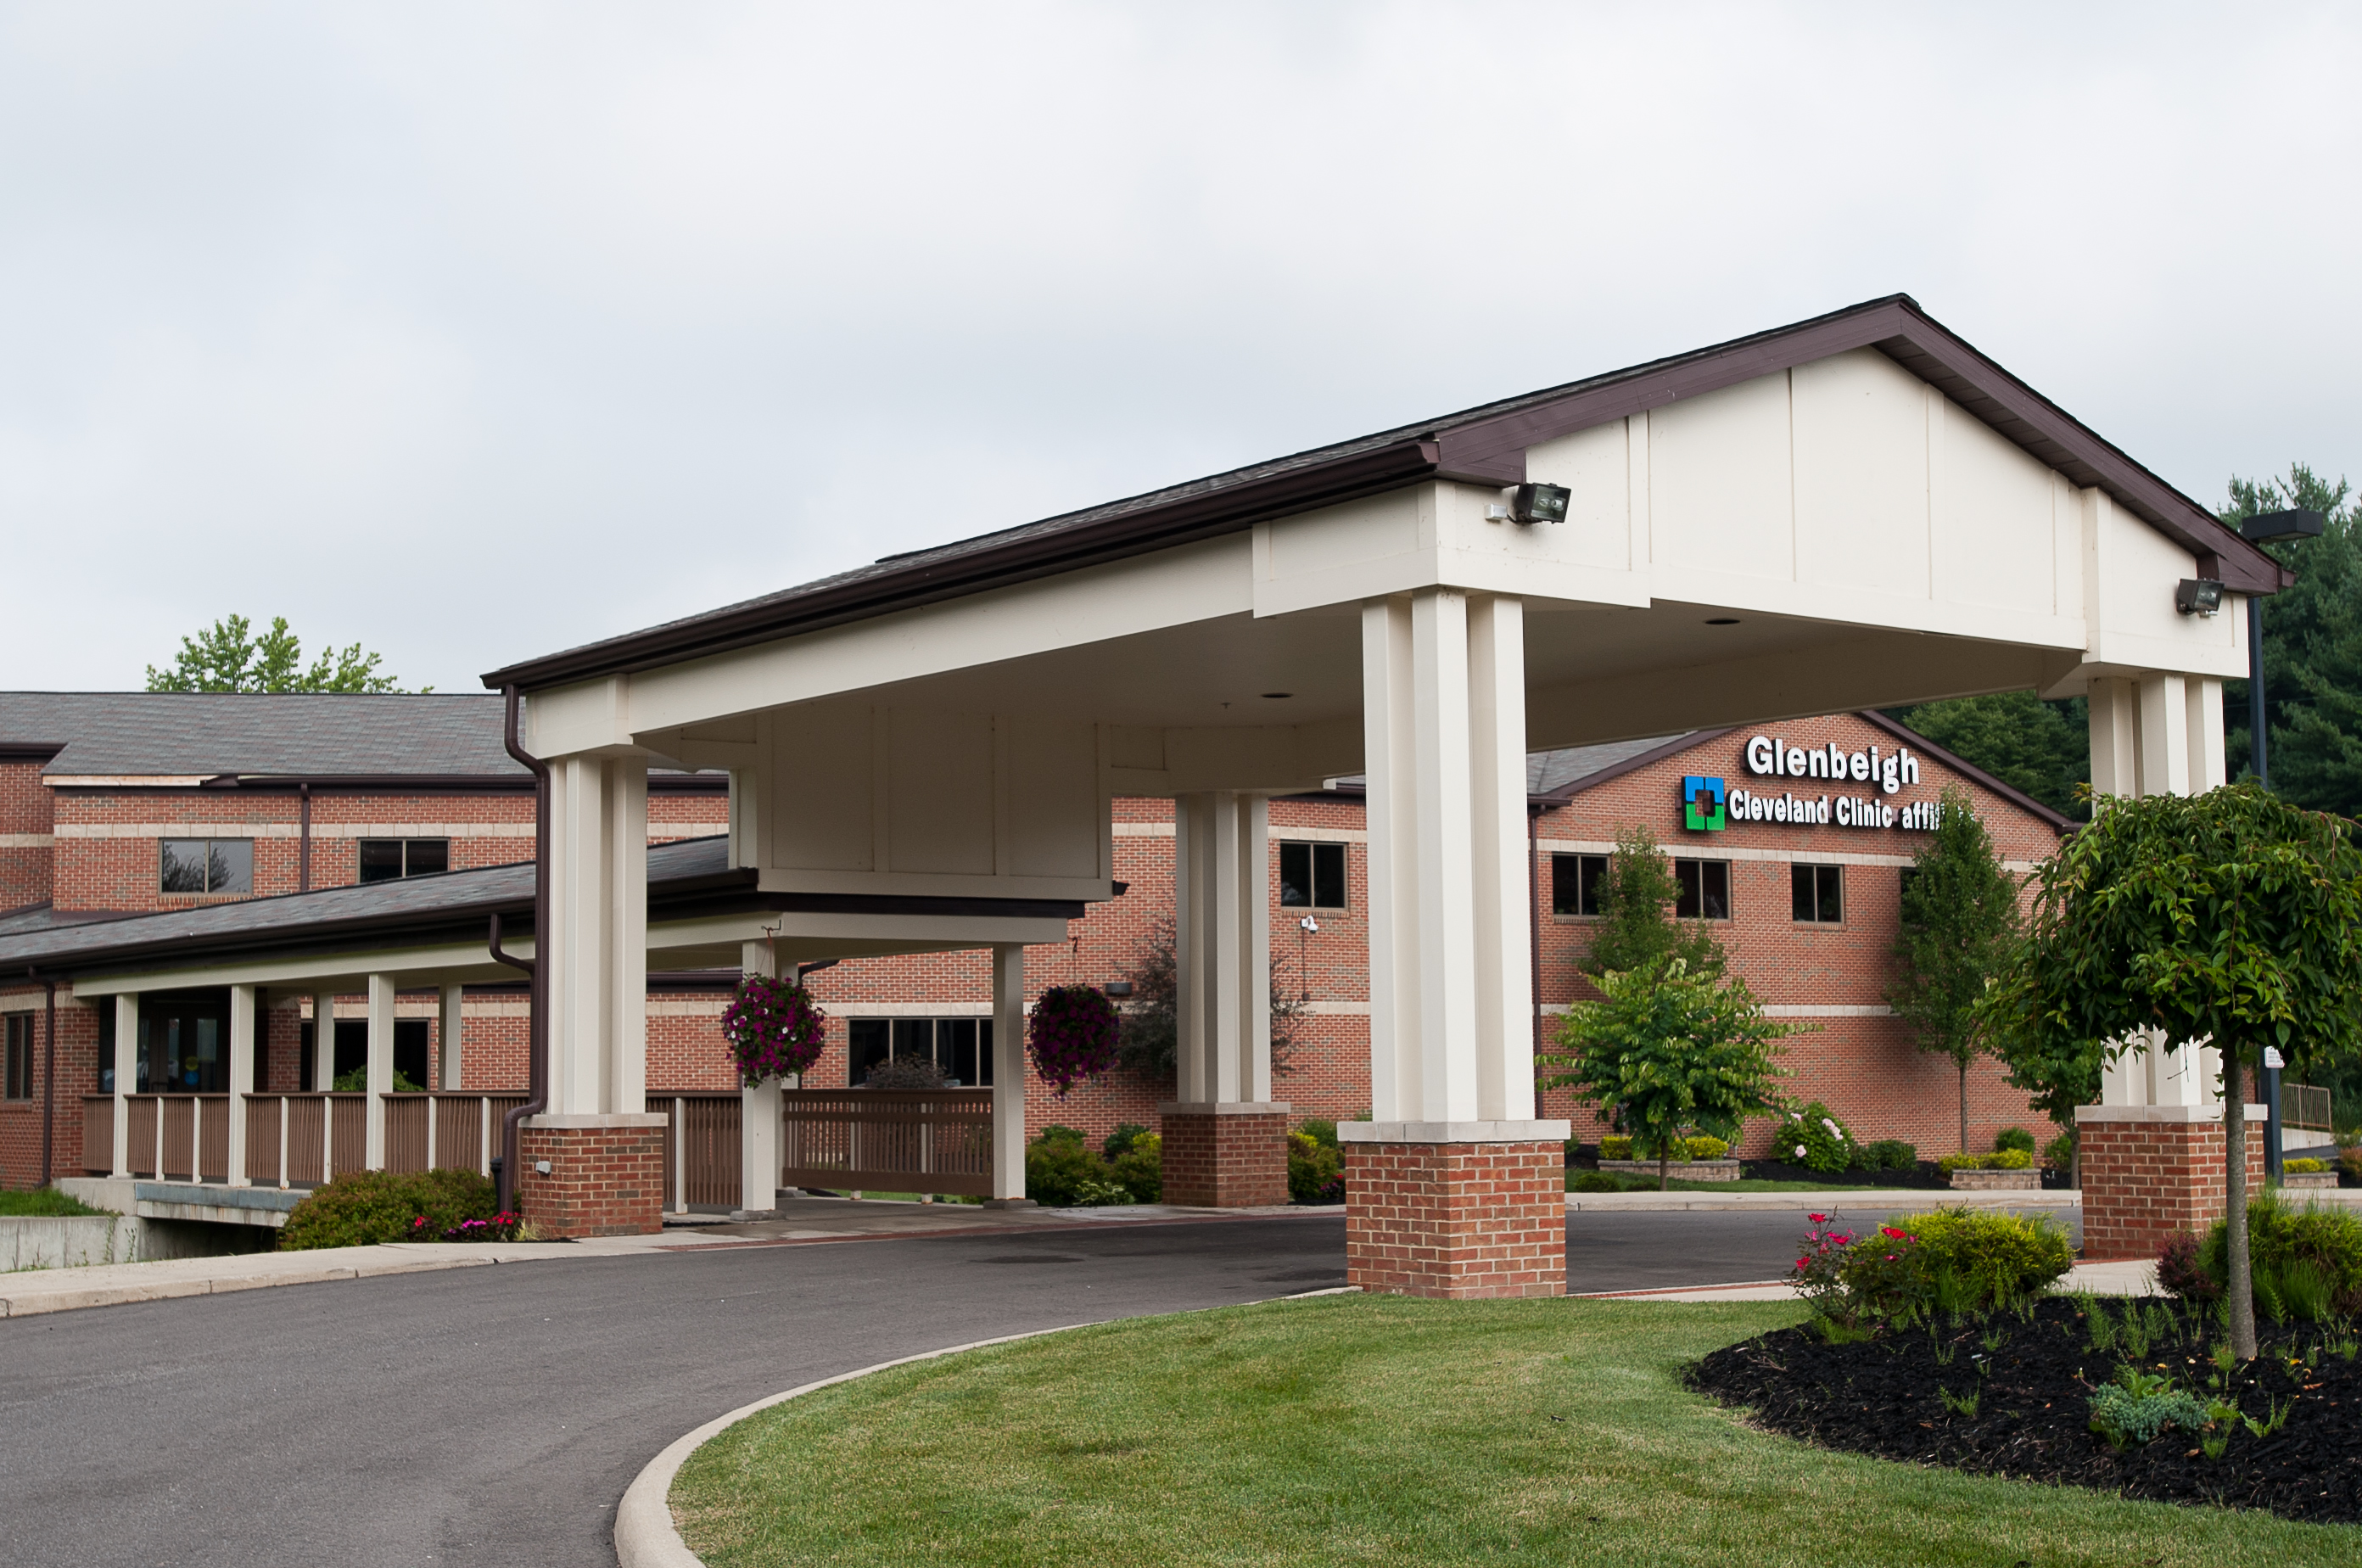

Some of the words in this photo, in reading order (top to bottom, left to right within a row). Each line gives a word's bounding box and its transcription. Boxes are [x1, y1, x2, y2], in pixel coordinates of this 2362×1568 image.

[1747, 736, 1919, 794] Glenbeigh
[1729, 789, 1829, 824] Cleveland
[1836, 796, 1893, 828] Clinic
